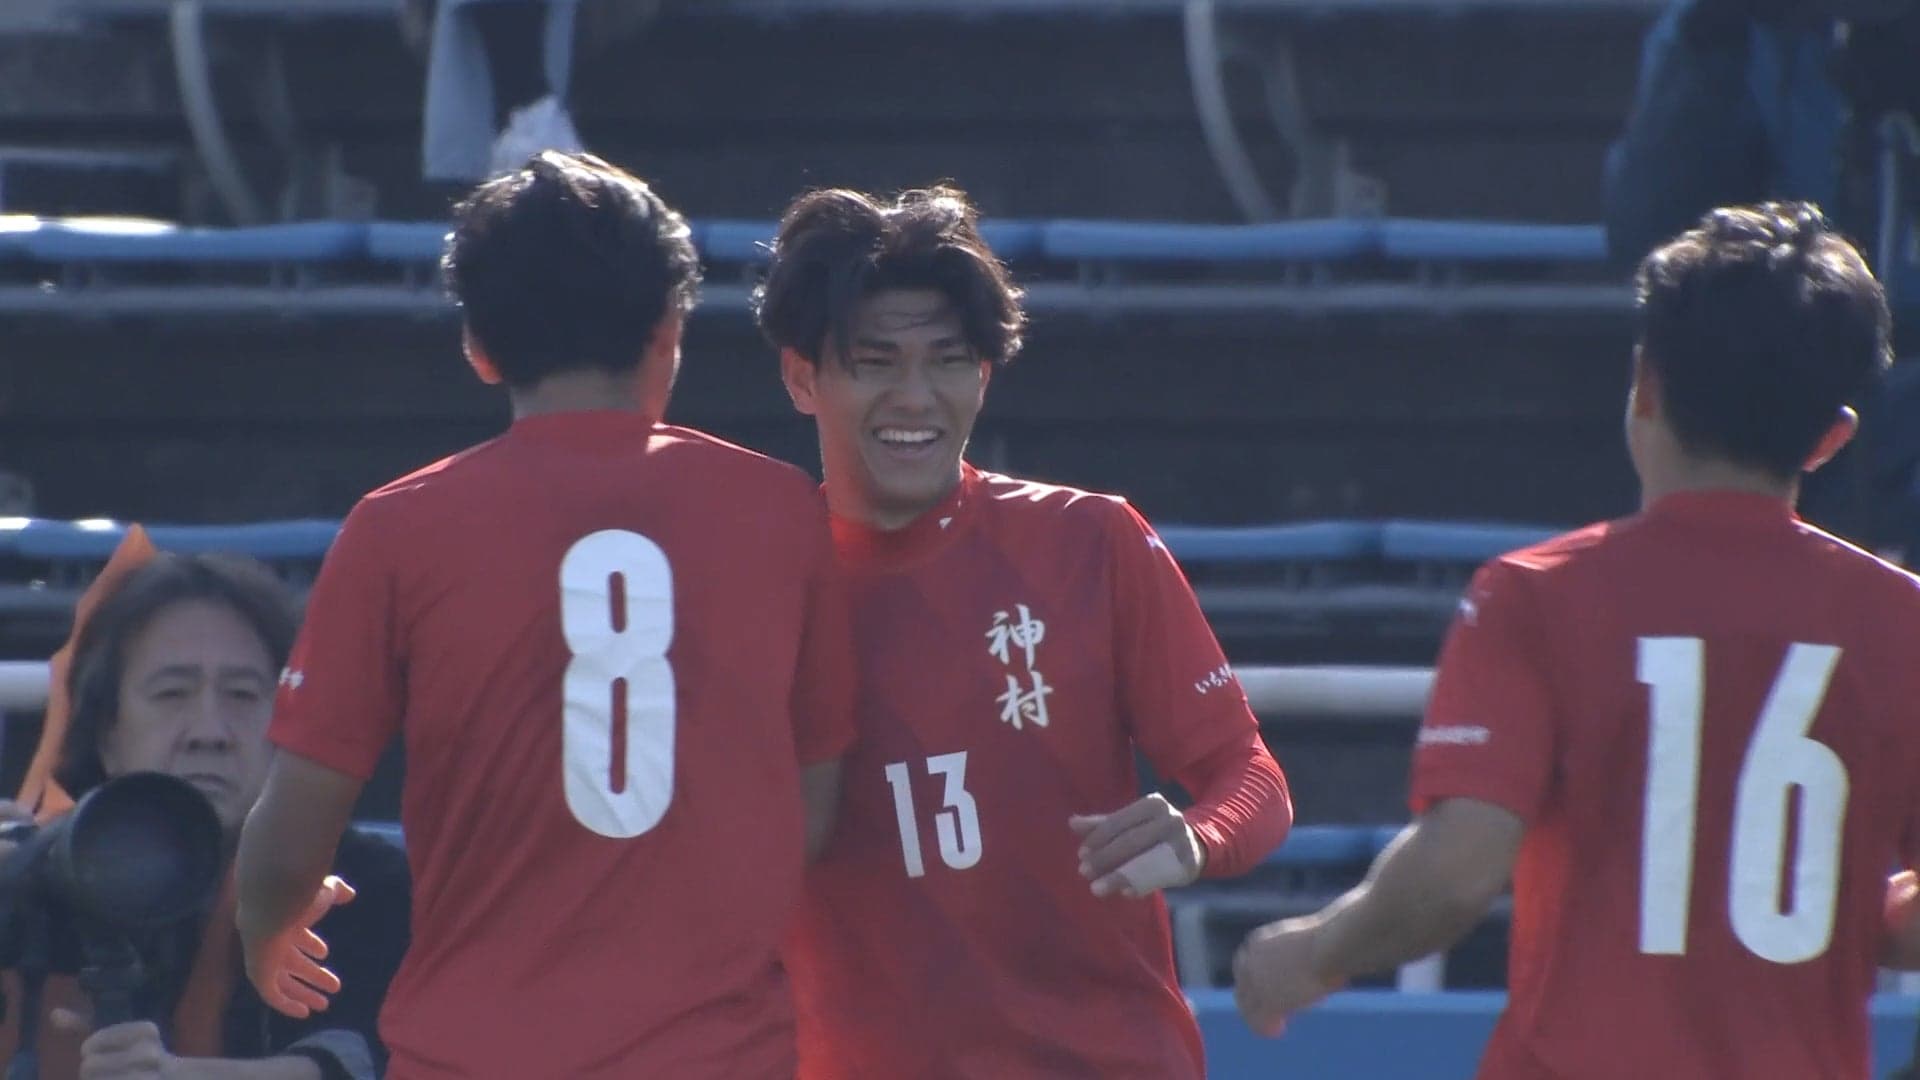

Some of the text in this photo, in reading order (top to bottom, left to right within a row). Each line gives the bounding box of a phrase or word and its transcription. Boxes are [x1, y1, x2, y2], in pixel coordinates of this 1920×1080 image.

[559, 529, 676, 839] 8
[985, 604, 1053, 730] 神村
[885, 751, 983, 878] 13
[1637, 636, 1847, 965] 16
